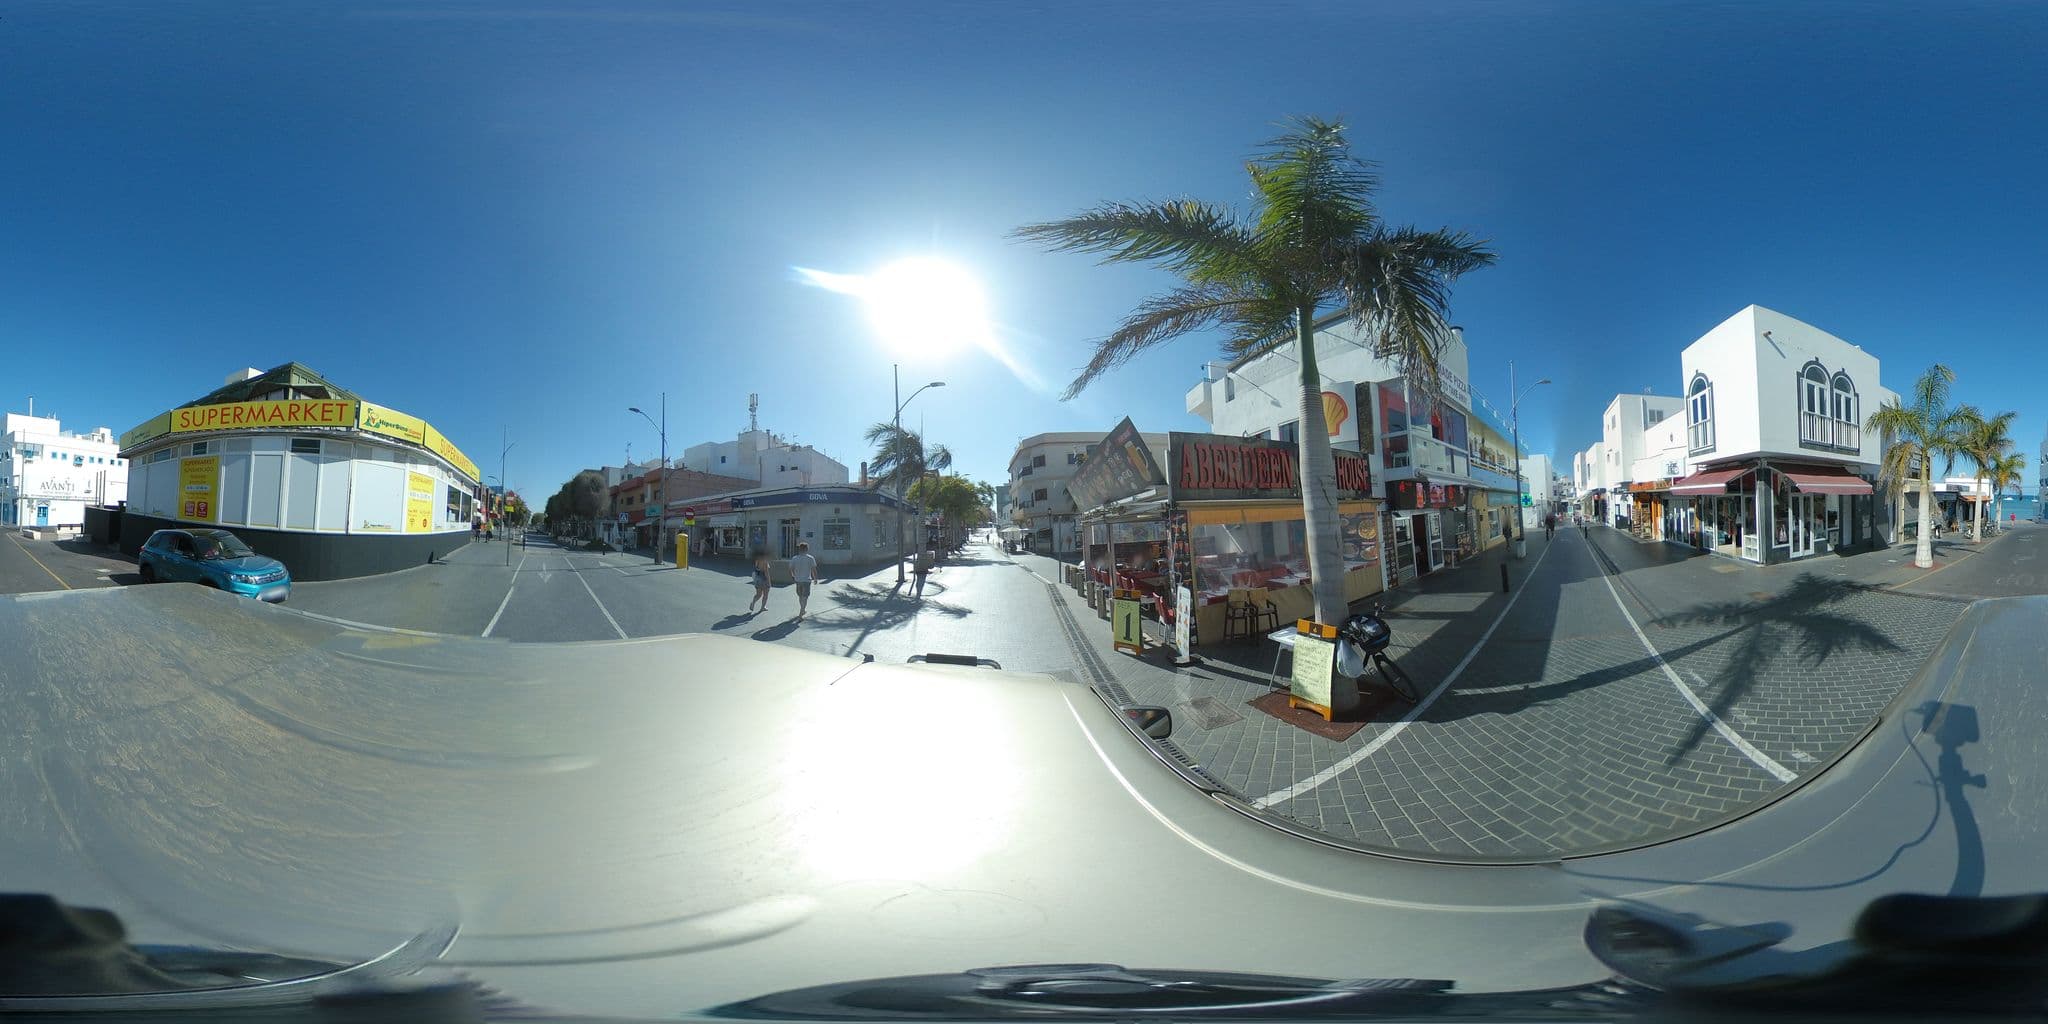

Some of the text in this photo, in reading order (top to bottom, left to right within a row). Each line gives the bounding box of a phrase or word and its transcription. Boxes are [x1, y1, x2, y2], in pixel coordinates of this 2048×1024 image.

[180, 403, 348, 428] SUPERMARKET
[440, 438, 473, 474] SUPERMARKET
[1180, 443, 1294, 489] ABERDEEN
[1336, 455, 1368, 491] HOUSE
[40, 479, 75, 491] AVANTI
[809, 493, 828, 501] BBVA
[1123, 612, 1132, 642] 1
